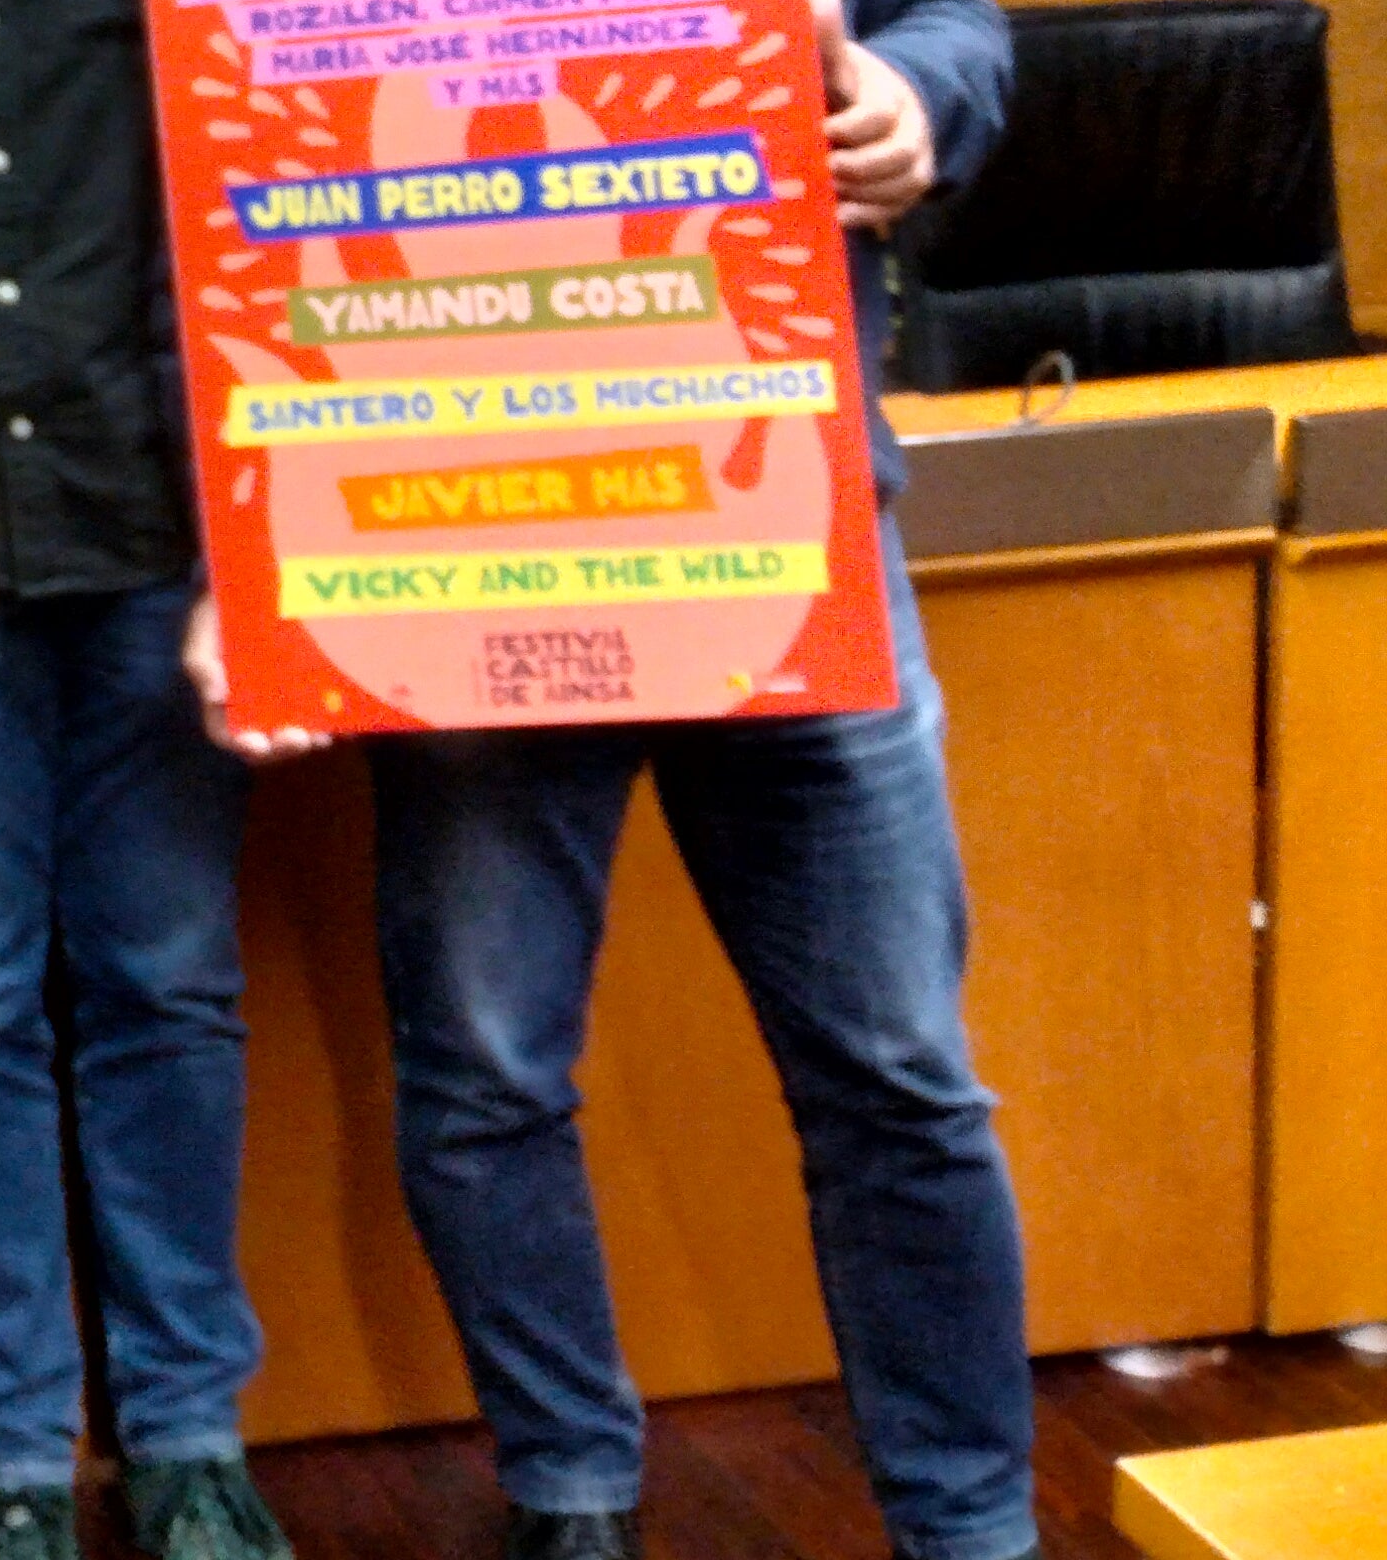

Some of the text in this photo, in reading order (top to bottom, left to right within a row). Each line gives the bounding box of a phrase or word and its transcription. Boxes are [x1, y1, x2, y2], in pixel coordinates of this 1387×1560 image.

[444, 78, 464, 104] Y
[247, 151, 758, 230] JUAN PERRO SEXTETO
[549, 269, 706, 321] COSTA
[248, 367, 826, 432] SANTERO Y LOS MUCHACHOS
[372, 461, 686, 521] JAVIER MAS
[306, 549, 785, 601] VICKY AND THE WILD
